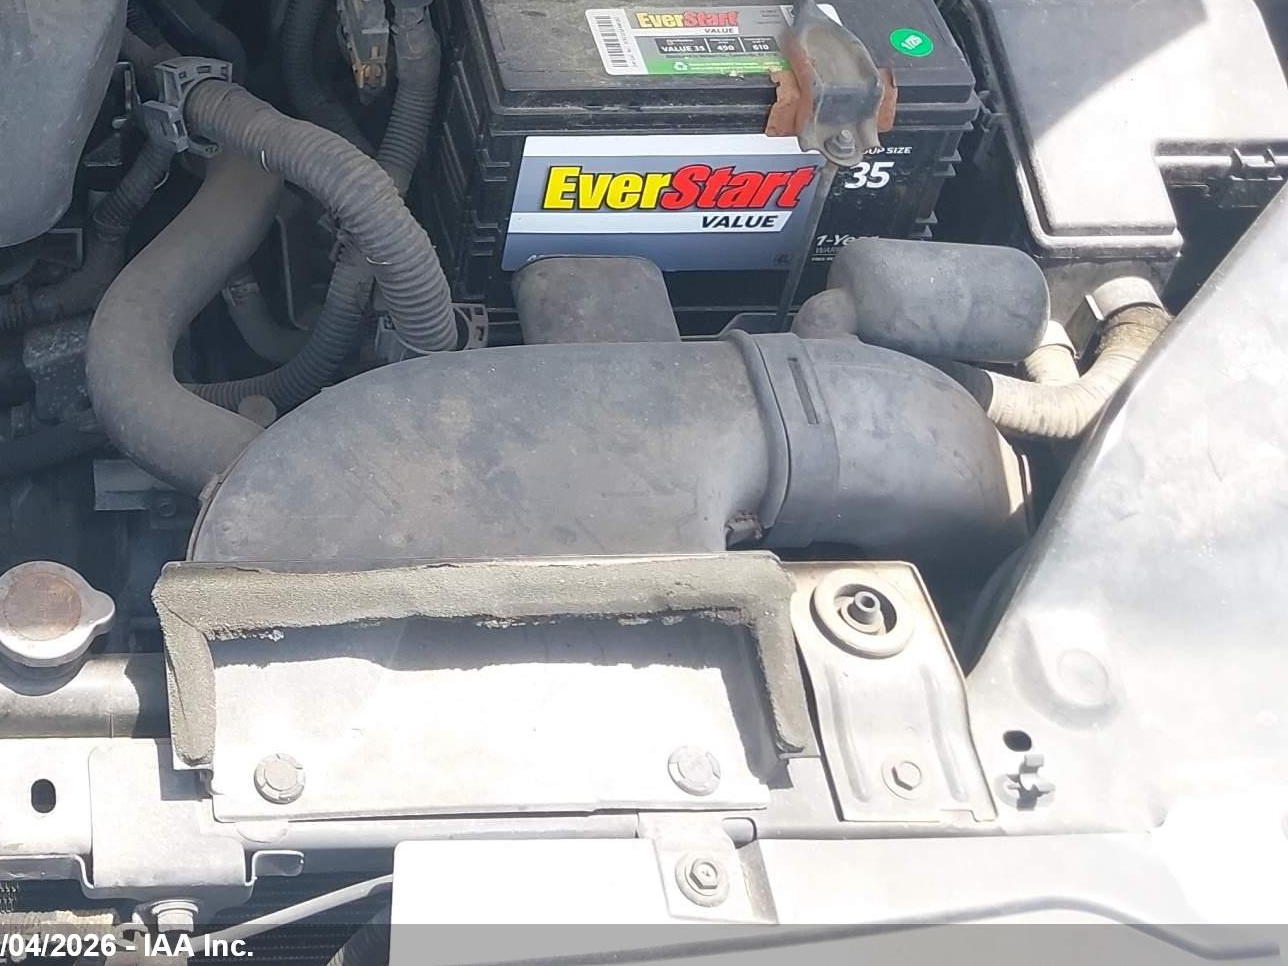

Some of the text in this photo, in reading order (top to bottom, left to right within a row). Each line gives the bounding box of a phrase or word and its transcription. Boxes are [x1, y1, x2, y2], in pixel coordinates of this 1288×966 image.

[636, 11, 739, 28] EverStart
[885, 146, 913, 155] SIZE
[844, 161, 895, 189] 35
[542, 164, 818, 211] EverStart
[701, 215, 779, 229] VALUE
